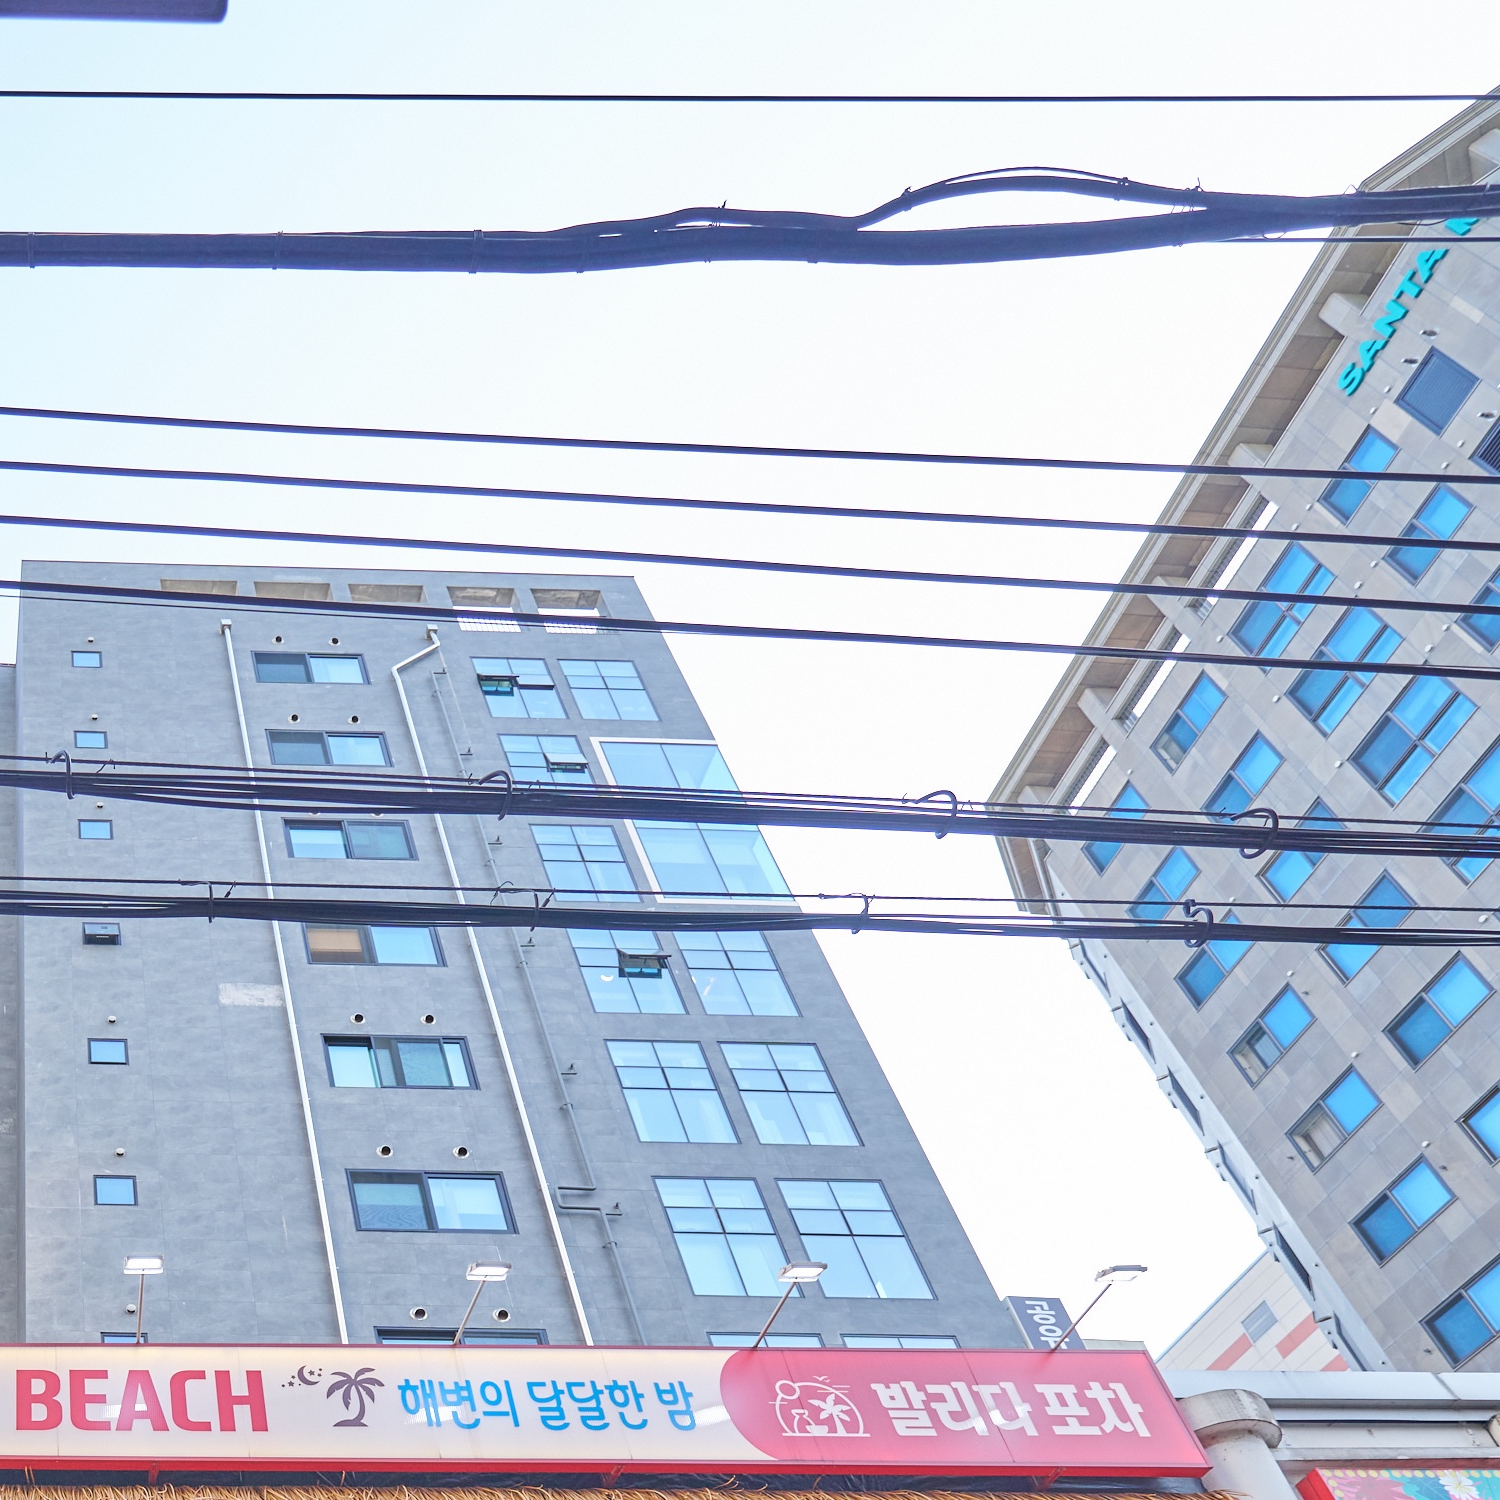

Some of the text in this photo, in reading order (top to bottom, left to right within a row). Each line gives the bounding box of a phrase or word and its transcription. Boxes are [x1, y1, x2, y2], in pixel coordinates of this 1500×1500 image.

[1338, 248, 1449, 396] SANTA
[15, 1369, 269, 1432] BEACH
[398, 1377, 697, 1432] 해변의 달달한 밤
[870, 1380, 1152, 1438] 발리다 포차
